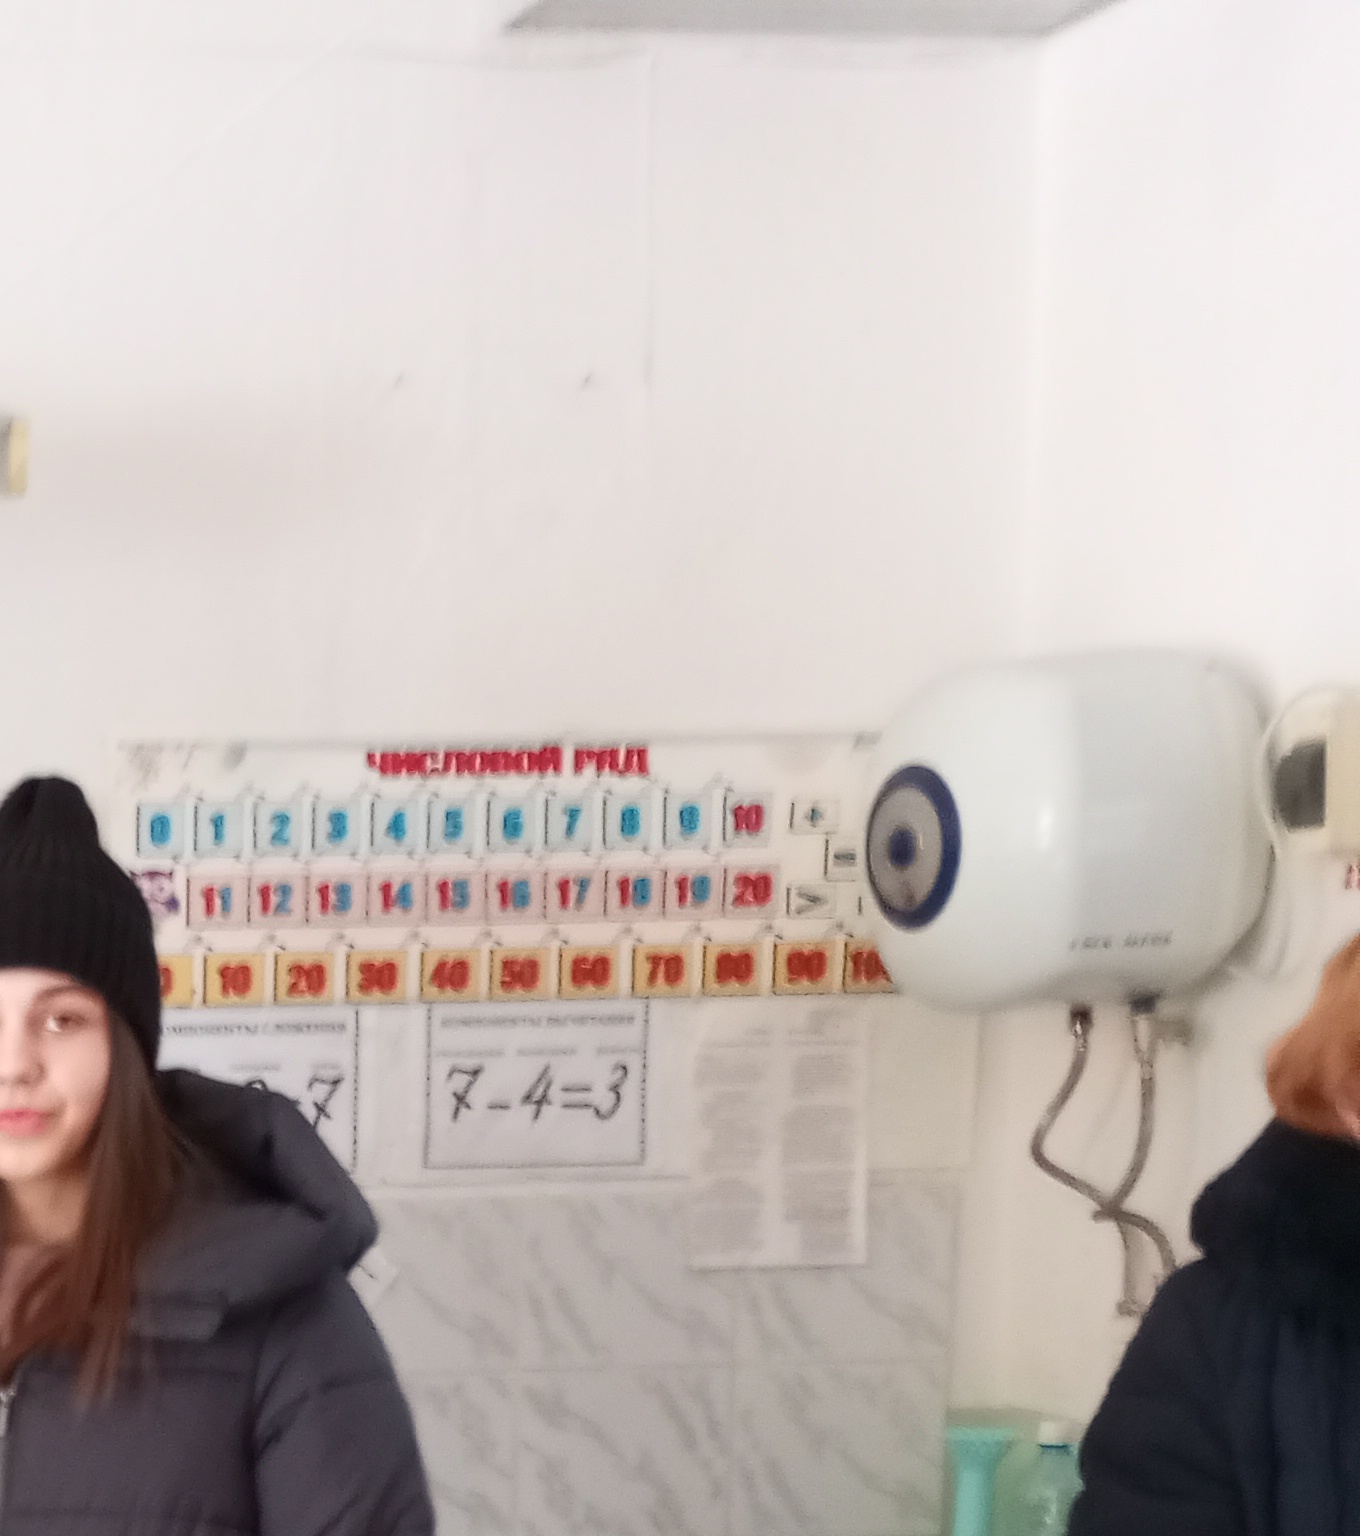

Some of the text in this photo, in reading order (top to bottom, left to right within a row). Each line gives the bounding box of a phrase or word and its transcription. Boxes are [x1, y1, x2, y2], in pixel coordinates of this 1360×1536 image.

[366, 746, 563, 777] ЧИСЛОВОЙ
[150, 813, 172, 845] 0
[210, 814, 225, 845] 1
[271, 812, 291, 846] 2
[328, 811, 348, 843] 3
[386, 810, 407, 842] 4
[444, 807, 464, 842] 5
[502, 806, 524, 840] 6
[564, 806, 581, 839] 7
[619, 804, 641, 838] 8
[679, 804, 701, 836] 9
[733, 803, 765, 834] 10
[202, 885, 233, 918] 11
[259, 883, 293, 914] 12
[317, 881, 352, 914] 13
[381, 880, 414, 912] 14
[438, 878, 471, 911] 15
[497, 878, 530, 910] 16
[557, 876, 590, 910] 17
[618, 876, 651, 908] 18
[676, 874, 711, 909] 19
[732, 872, 774, 906] 20
[220, 963, 253, 996] 10
[287, 963, 327, 997] 20
[358, 960, 399, 994] 30
[430, 959, 470, 991] 40
[646, 952, 685, 986] 70
